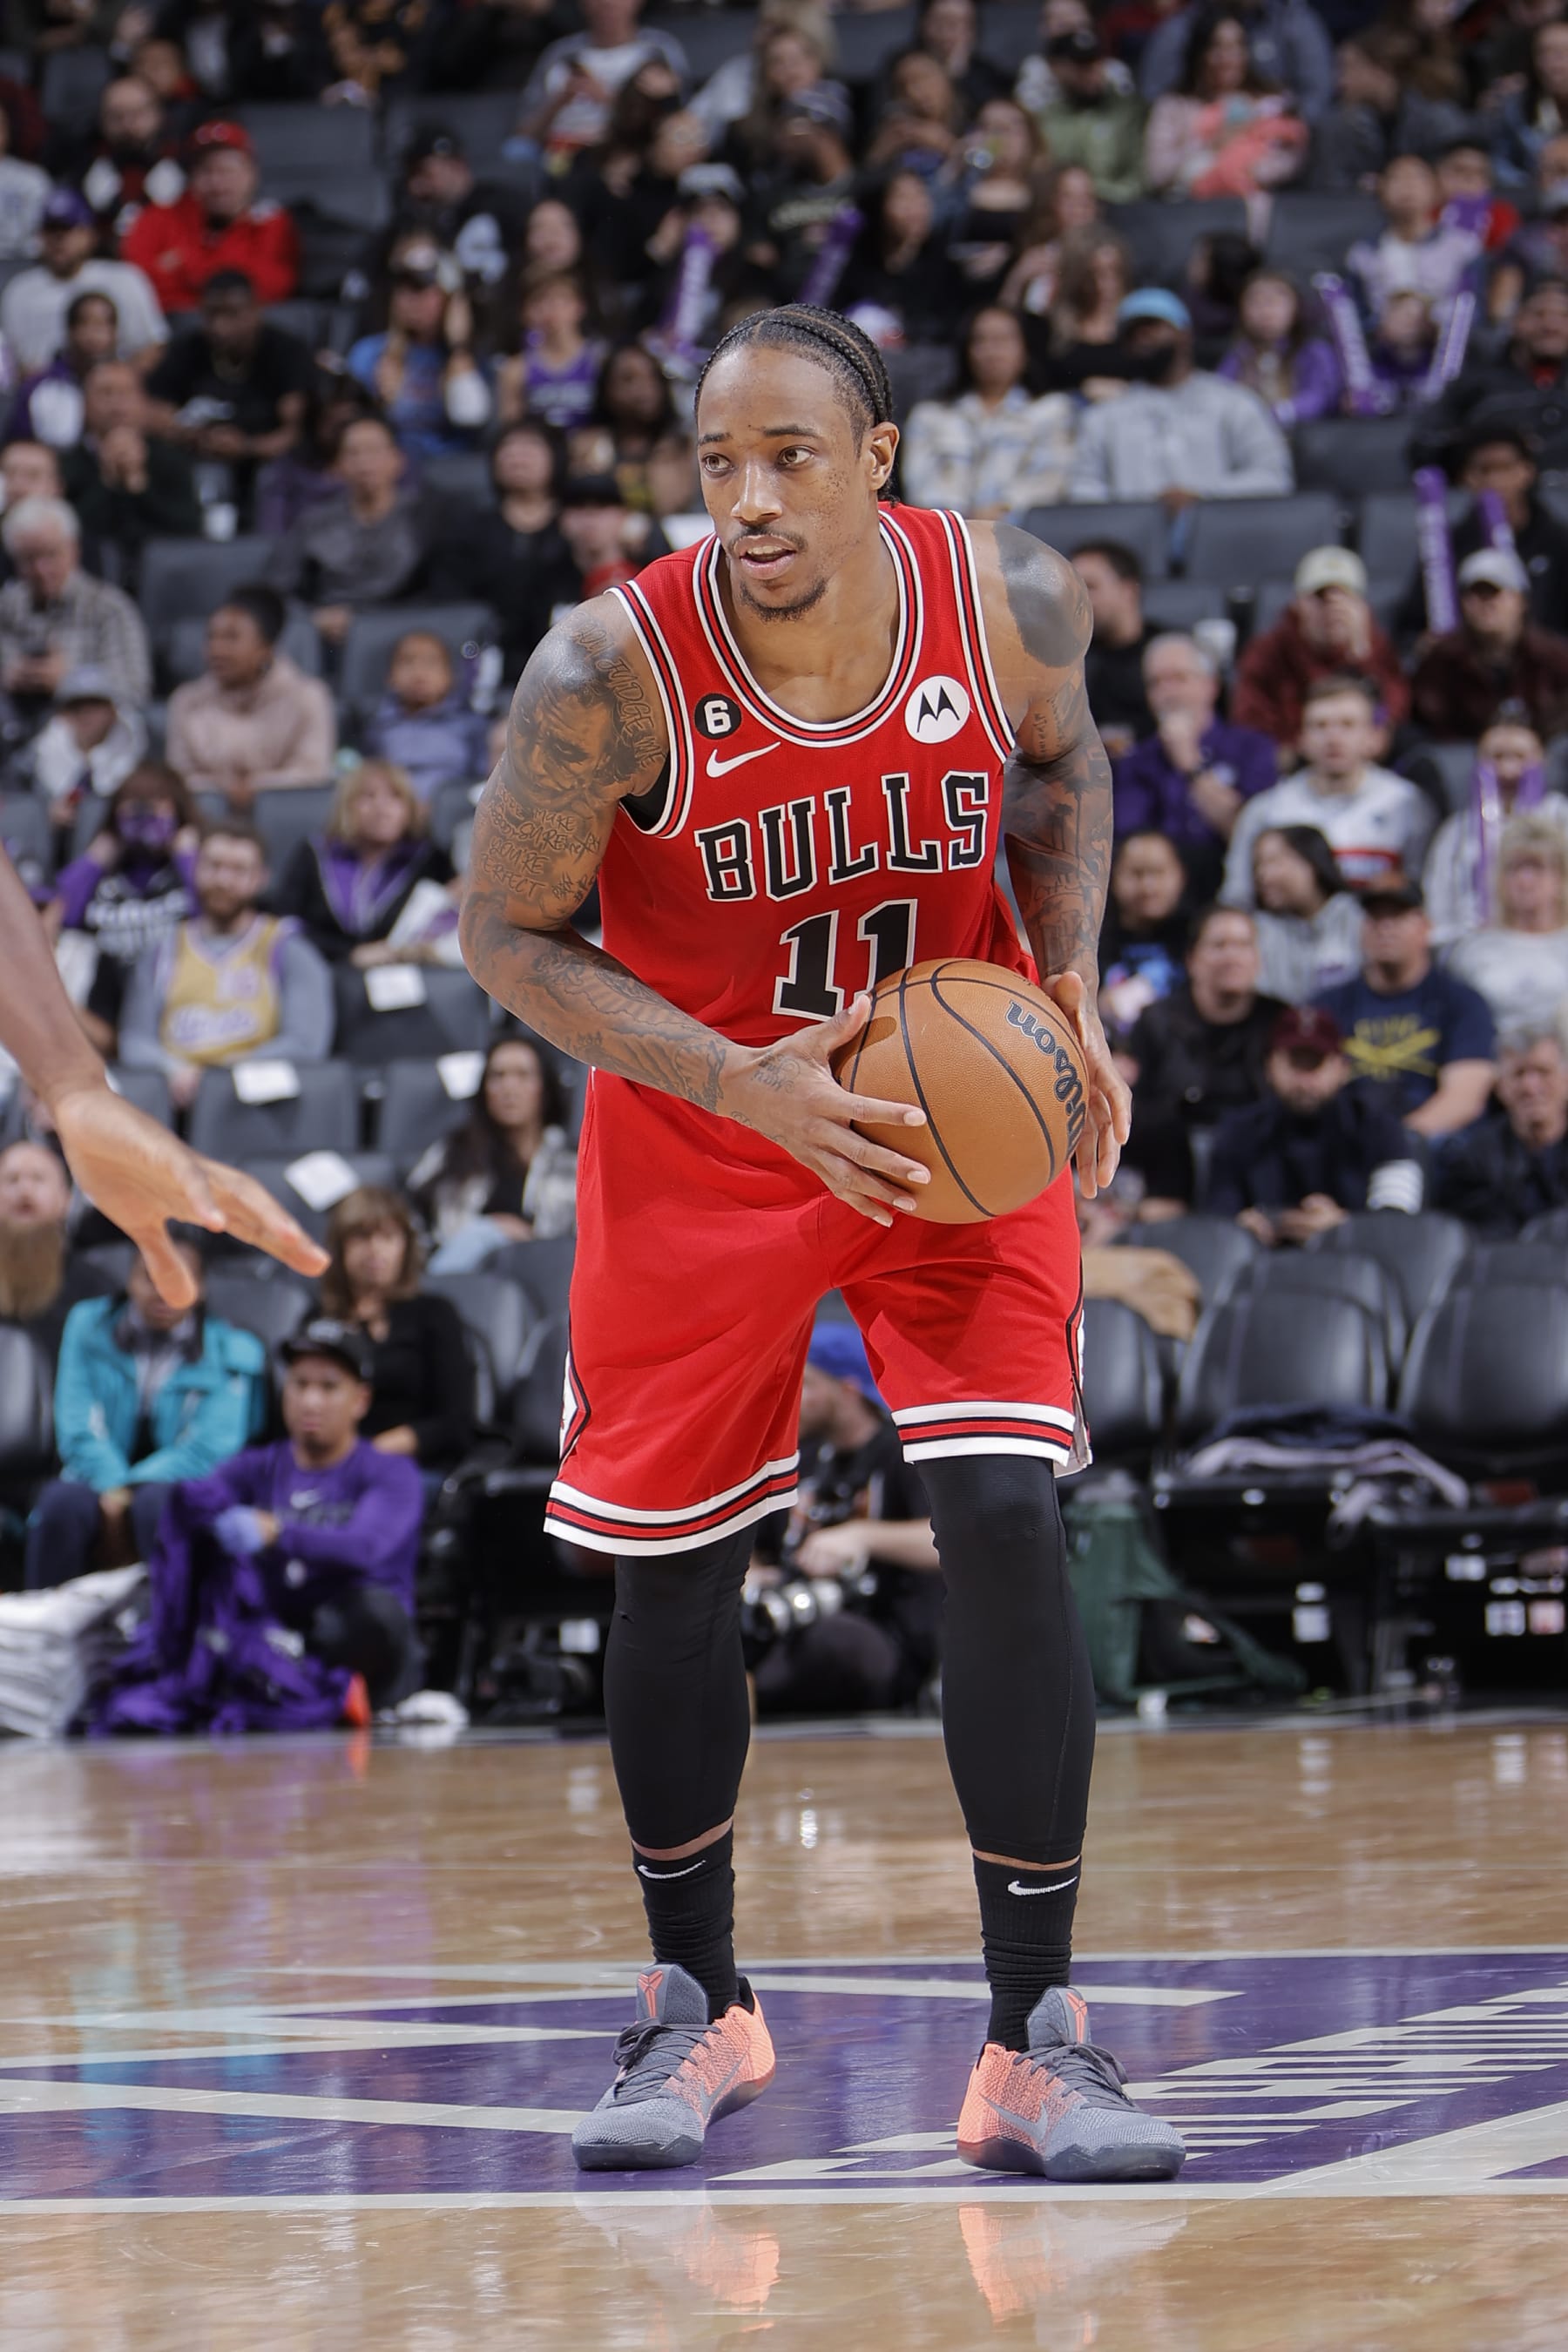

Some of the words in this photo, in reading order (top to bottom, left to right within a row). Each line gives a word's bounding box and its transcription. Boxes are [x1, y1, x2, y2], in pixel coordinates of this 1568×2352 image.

[702, 700, 733, 733] 6
[693, 770, 990, 902] BULLS
[772, 898, 918, 1023] 11
